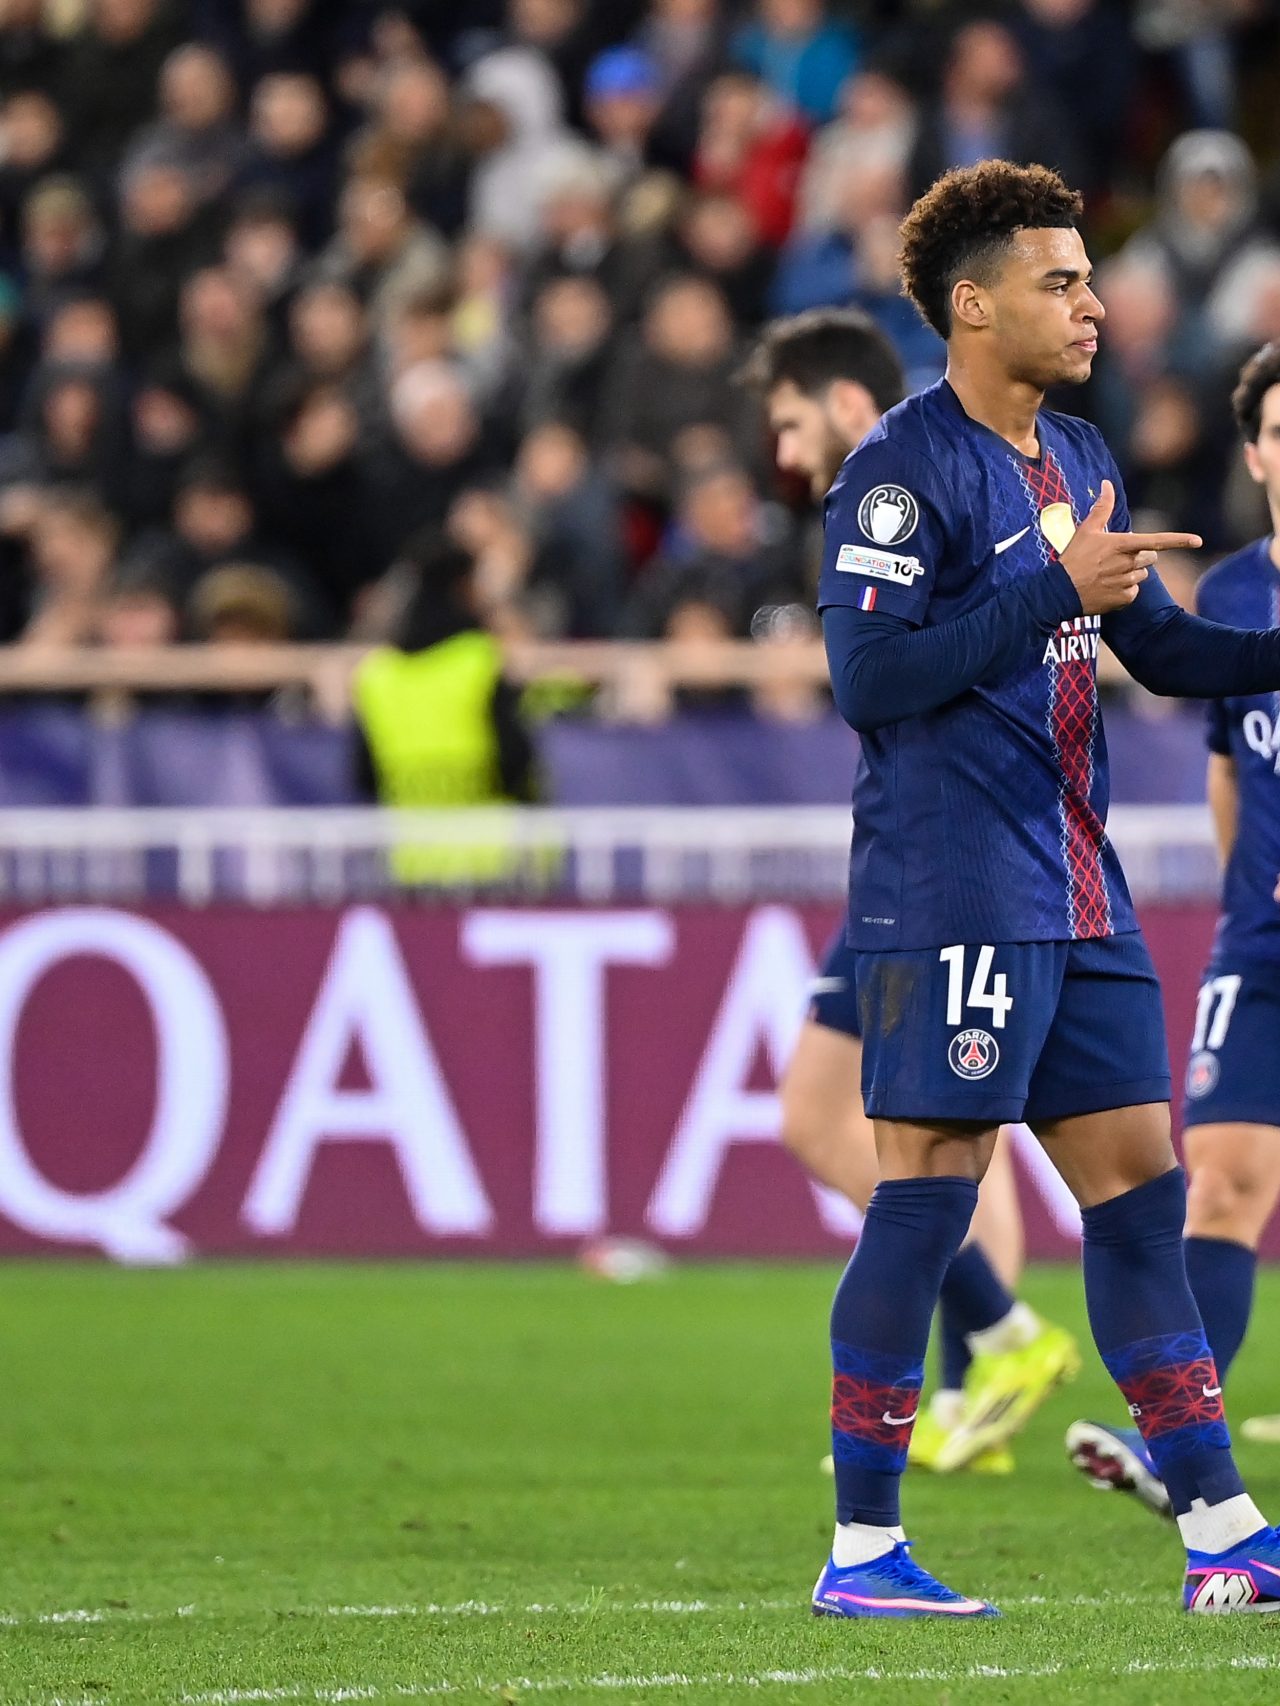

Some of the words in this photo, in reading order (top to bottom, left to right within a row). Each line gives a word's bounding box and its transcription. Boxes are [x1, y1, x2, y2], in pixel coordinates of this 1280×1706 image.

[938, 944, 1014, 1030] 14
[1190, 973, 1243, 1053] 17
[956, 1030, 991, 1046] PARIS
